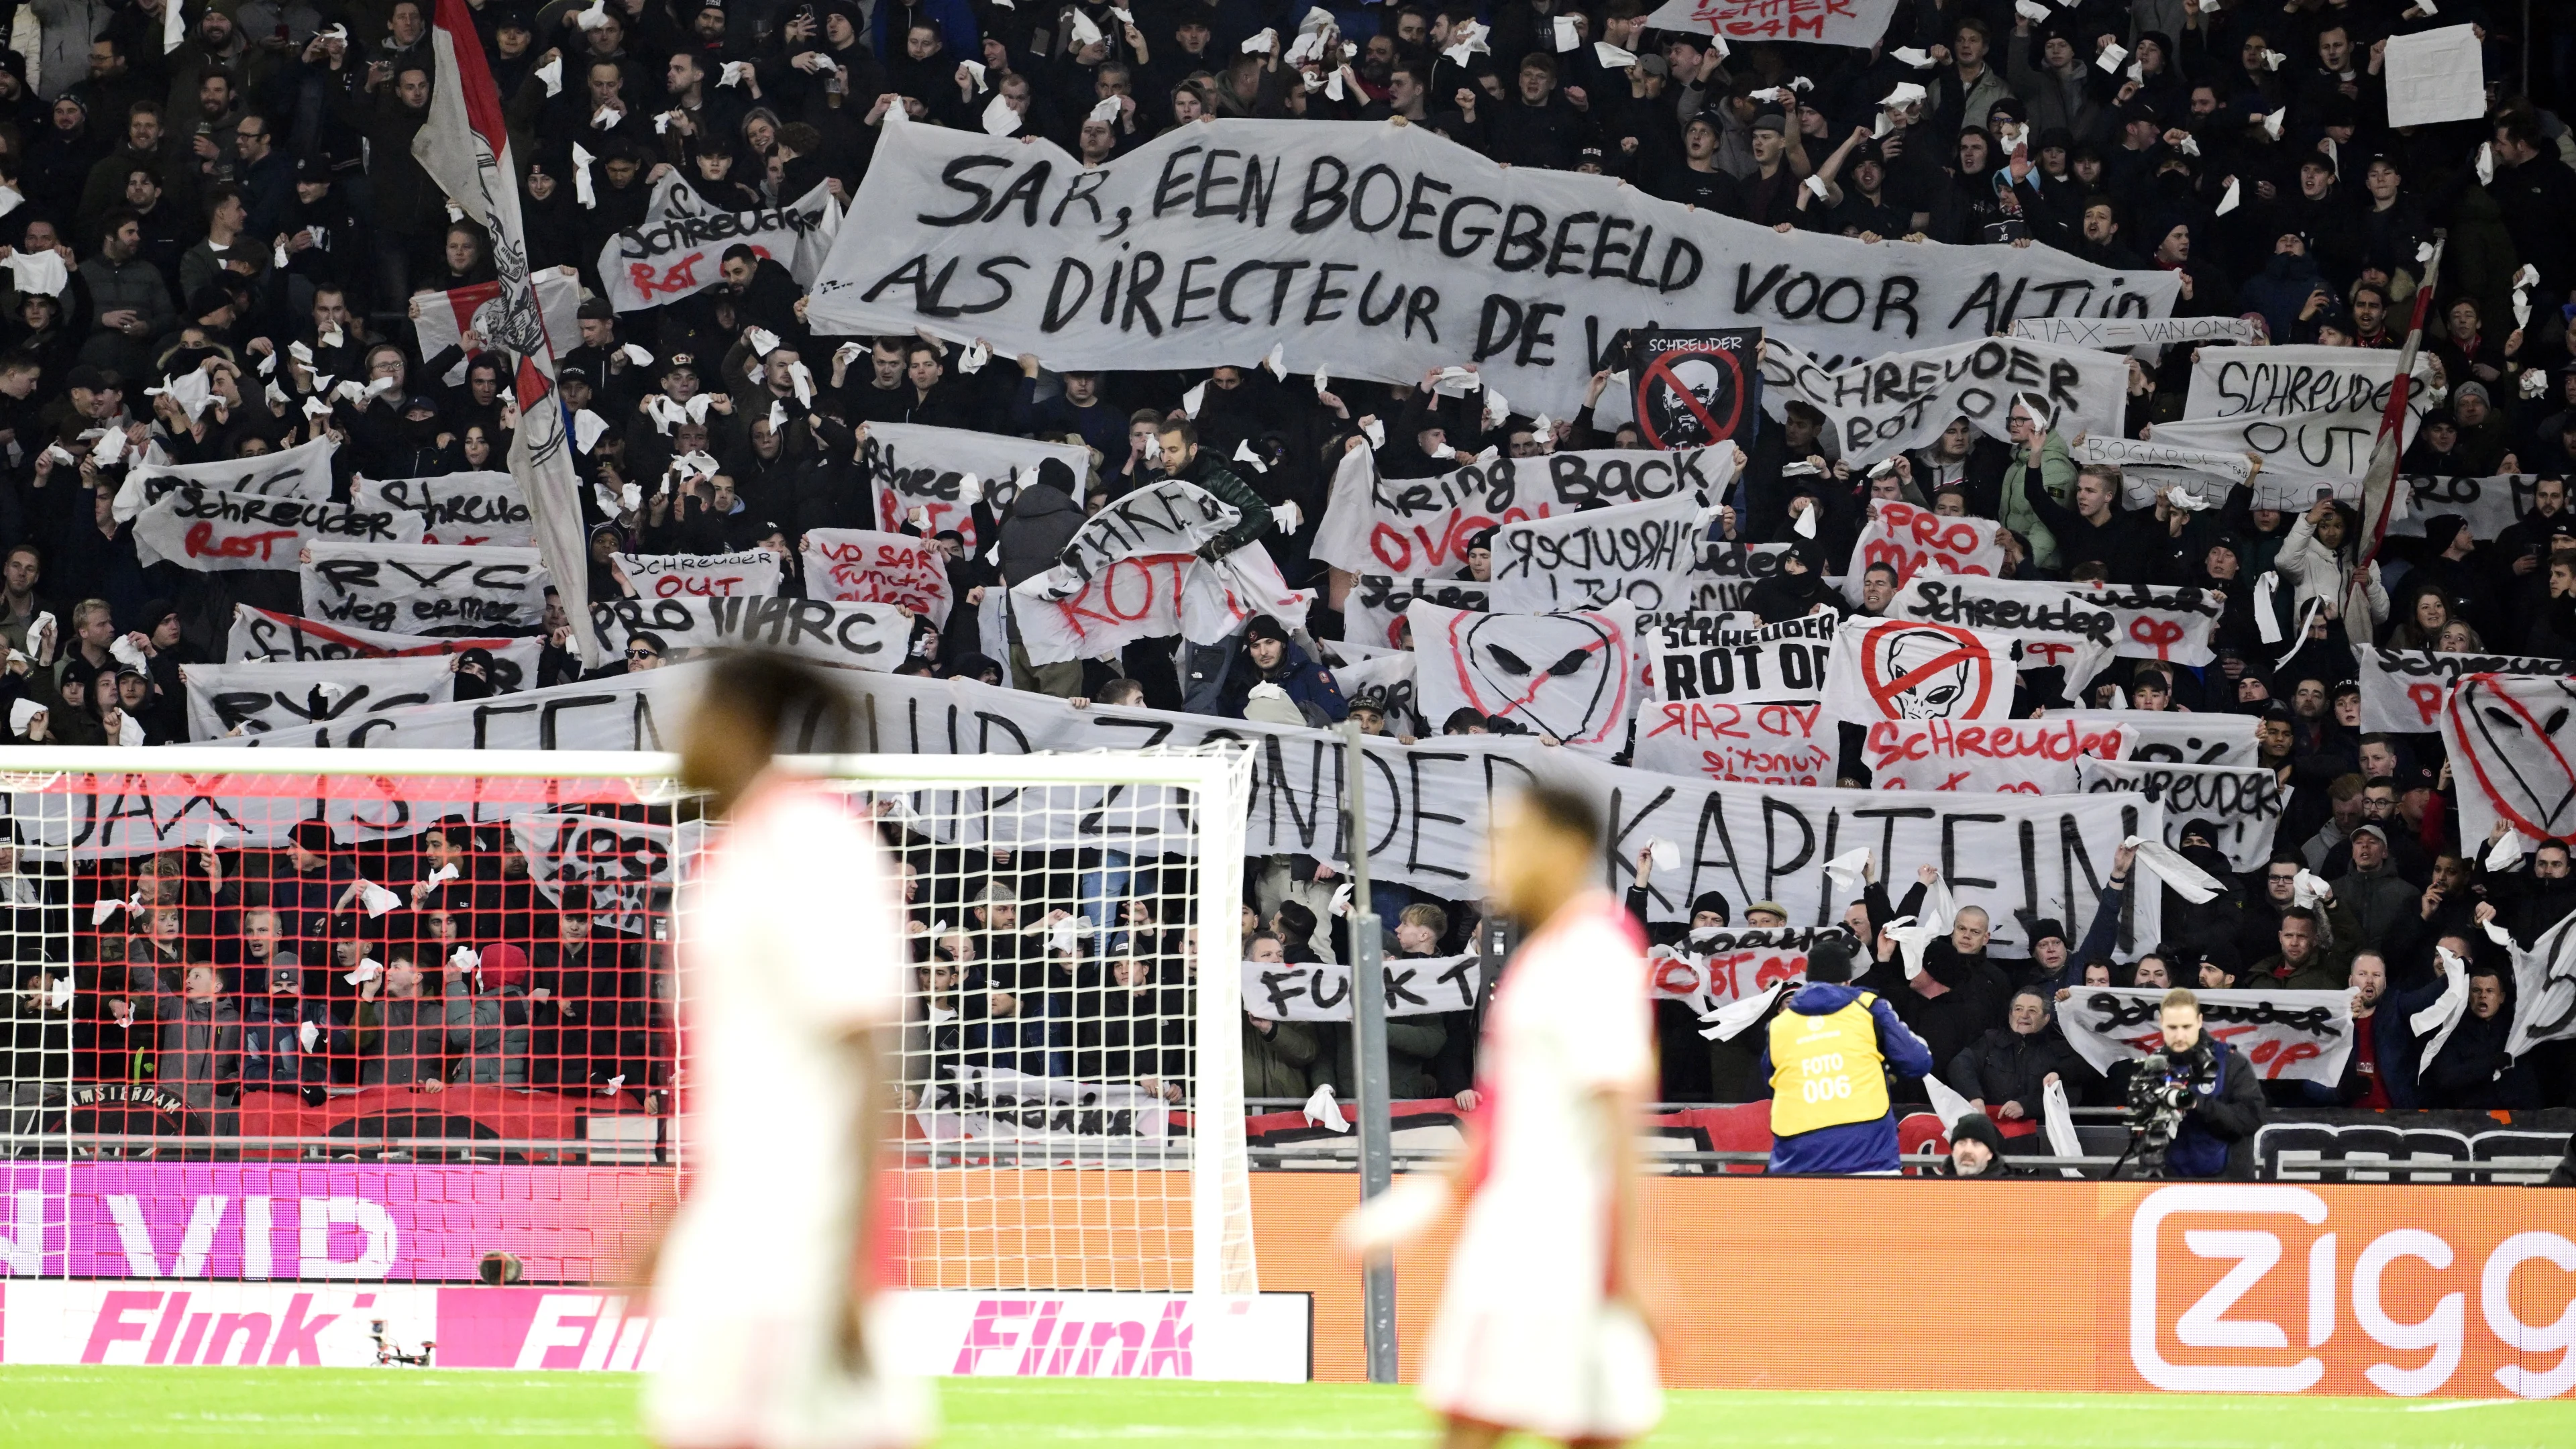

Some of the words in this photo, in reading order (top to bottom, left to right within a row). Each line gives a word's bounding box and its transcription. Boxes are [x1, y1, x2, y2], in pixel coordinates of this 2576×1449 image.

[917, 154, 1132, 240] SAR,
[1152, 144, 1280, 228] EEN
[1290, 155, 1703, 293] BOEGBEELD
[1733, 262, 1920, 337] VOOR
[860, 253, 1031, 318] ALS
[1040, 240, 1440, 343] DIRECTEUR
[1472, 292, 1565, 366] DE
[1649, 337, 1743, 352] SCHREUDER
[2015, 319, 2102, 344] AJAX
[2141, 321, 2186, 341] VAN
[2192, 318, 2249, 336] ONS
[1845, 396, 1935, 451] ROT
[2243, 421, 2370, 474] OUT
[2414, 474, 2481, 513] RO
[185, 521, 299, 561] ROT
[1881, 504, 1980, 555] PRO
[655, 575, 743, 598] OUT
[874, 544, 942, 579] SAR
[1055, 552, 1199, 643] ROT
[593, 598, 694, 651] PRO
[1664, 645, 1764, 702] ROT
[1607, 784, 2139, 955] KAPITEIN
[1801, 1053, 1844, 1077] FOTO
[1803, 1075, 1852, 1105] 006
[80, 1290, 343, 1367] Flink
